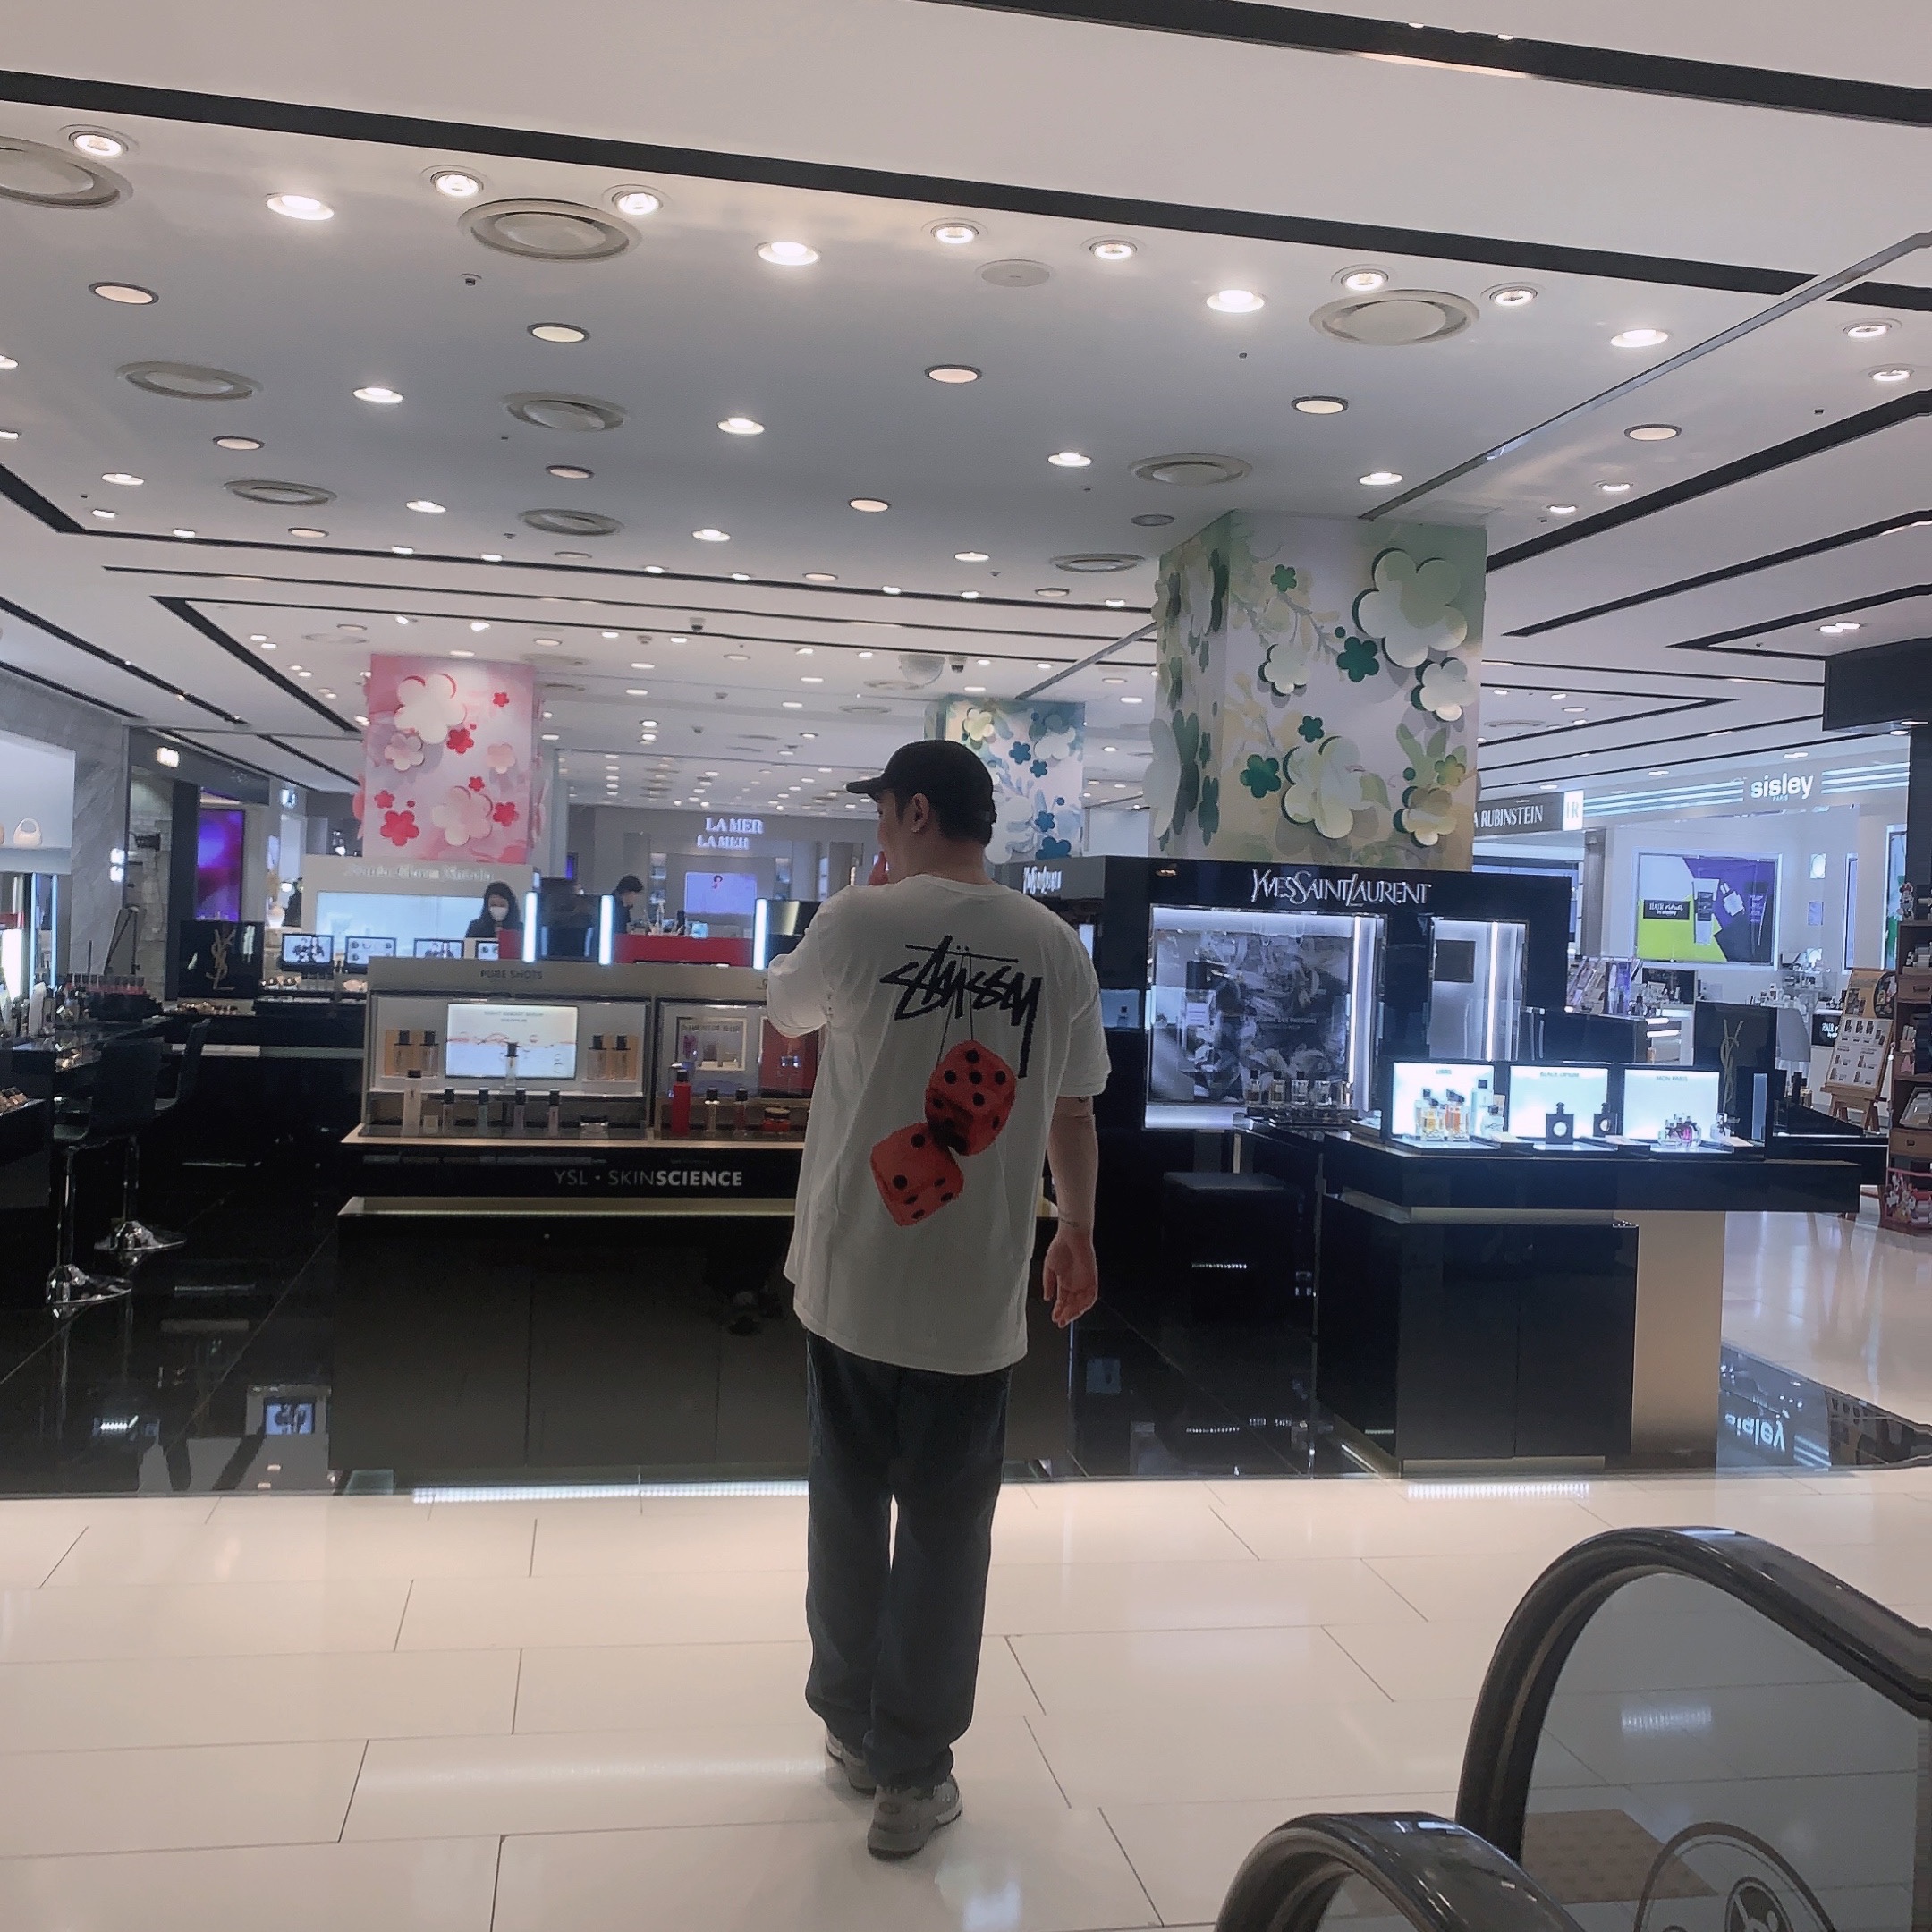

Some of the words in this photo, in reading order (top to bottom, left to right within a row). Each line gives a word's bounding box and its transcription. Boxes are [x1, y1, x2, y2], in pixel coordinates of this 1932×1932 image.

[1750, 772, 1814, 800] sisley
[1480, 805, 1544, 828] RUBINSTEIN
[706, 817, 727, 833] LA
[729, 818, 764, 835] MER
[510, 970, 543, 979] SHOTS
[555, 1169, 588, 1186] YSL
[607, 1169, 742, 1187] SKINSCIENCE
